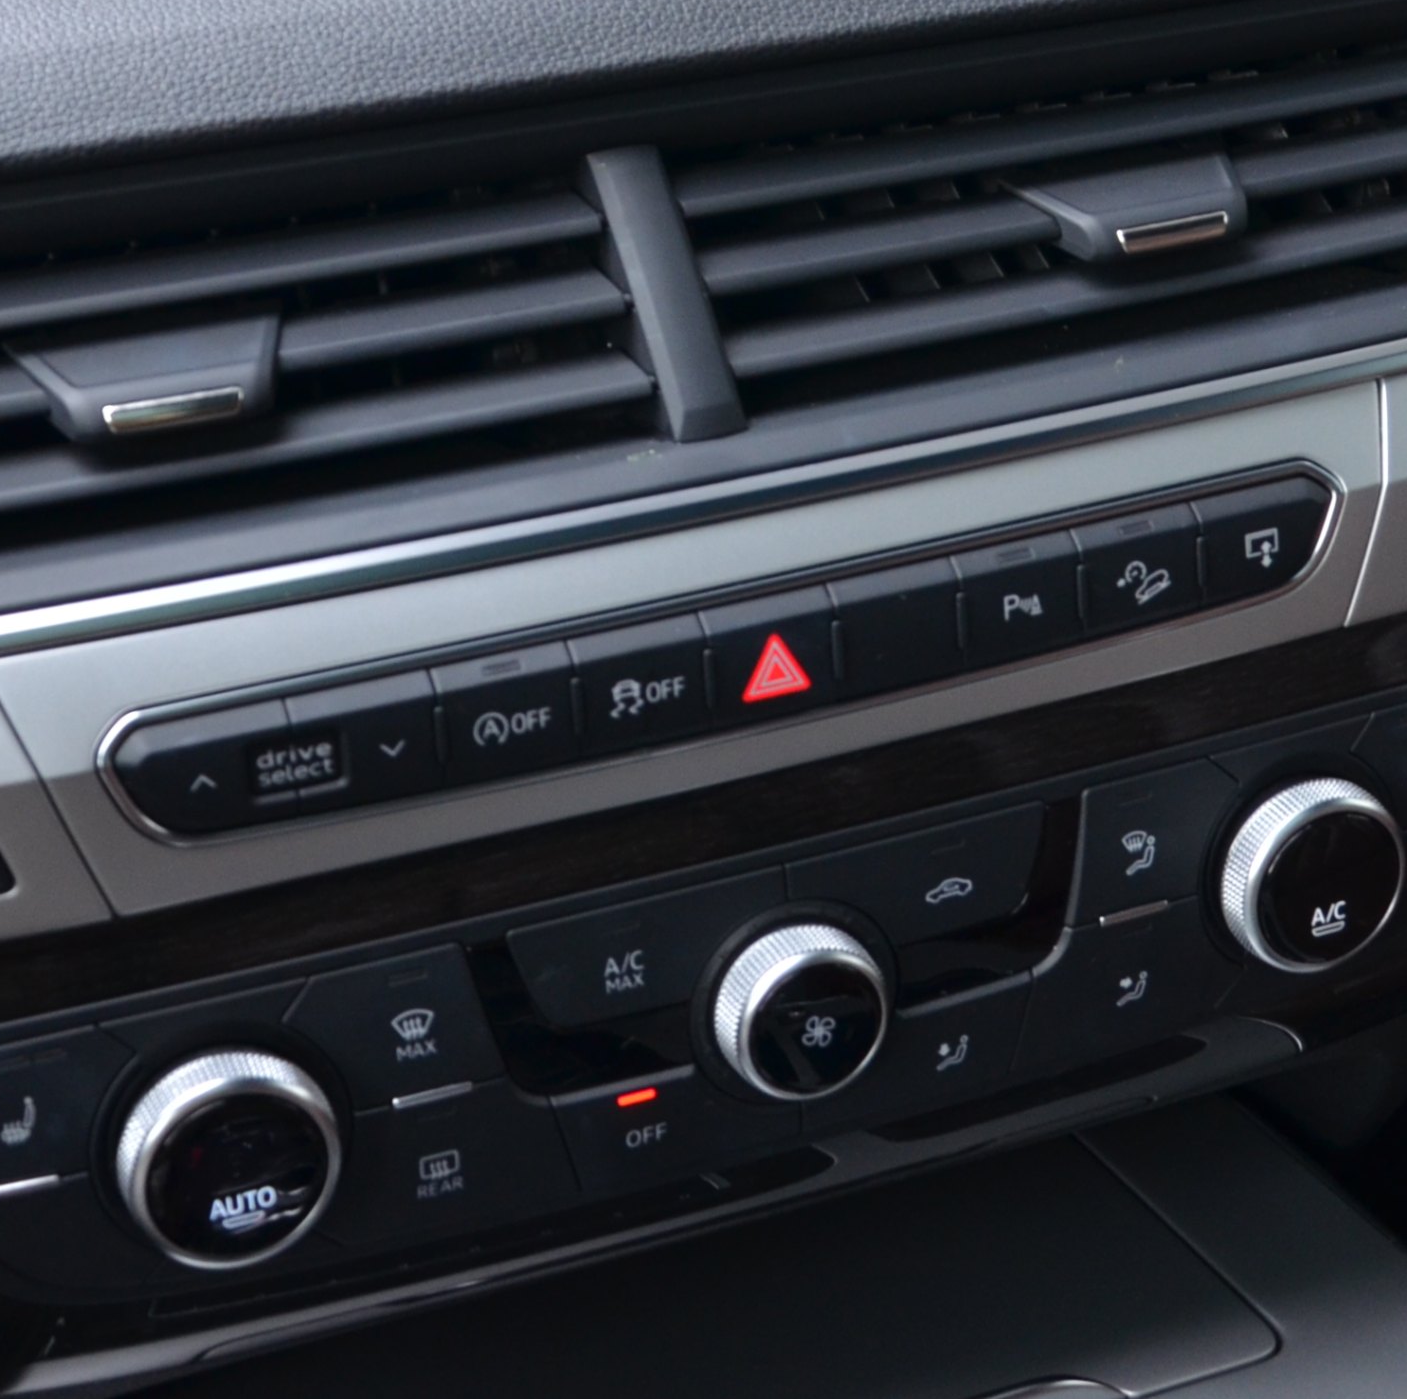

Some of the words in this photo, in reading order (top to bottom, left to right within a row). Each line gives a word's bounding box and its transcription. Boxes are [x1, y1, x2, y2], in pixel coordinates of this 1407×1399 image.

[644, 676, 686, 704] OFF
[511, 707, 552, 734] OFF
[256, 739, 333, 770] drive
[258, 758, 335, 788] select
[1311, 900, 1346, 927] A/C
[603, 950, 645, 977] A/C
[605, 971, 646, 994] MAX
[395, 1038, 437, 1061] MAX
[625, 1122, 668, 1148] OFF
[417, 1175, 464, 1199] REAR
[209, 1185, 277, 1221] AUTO
